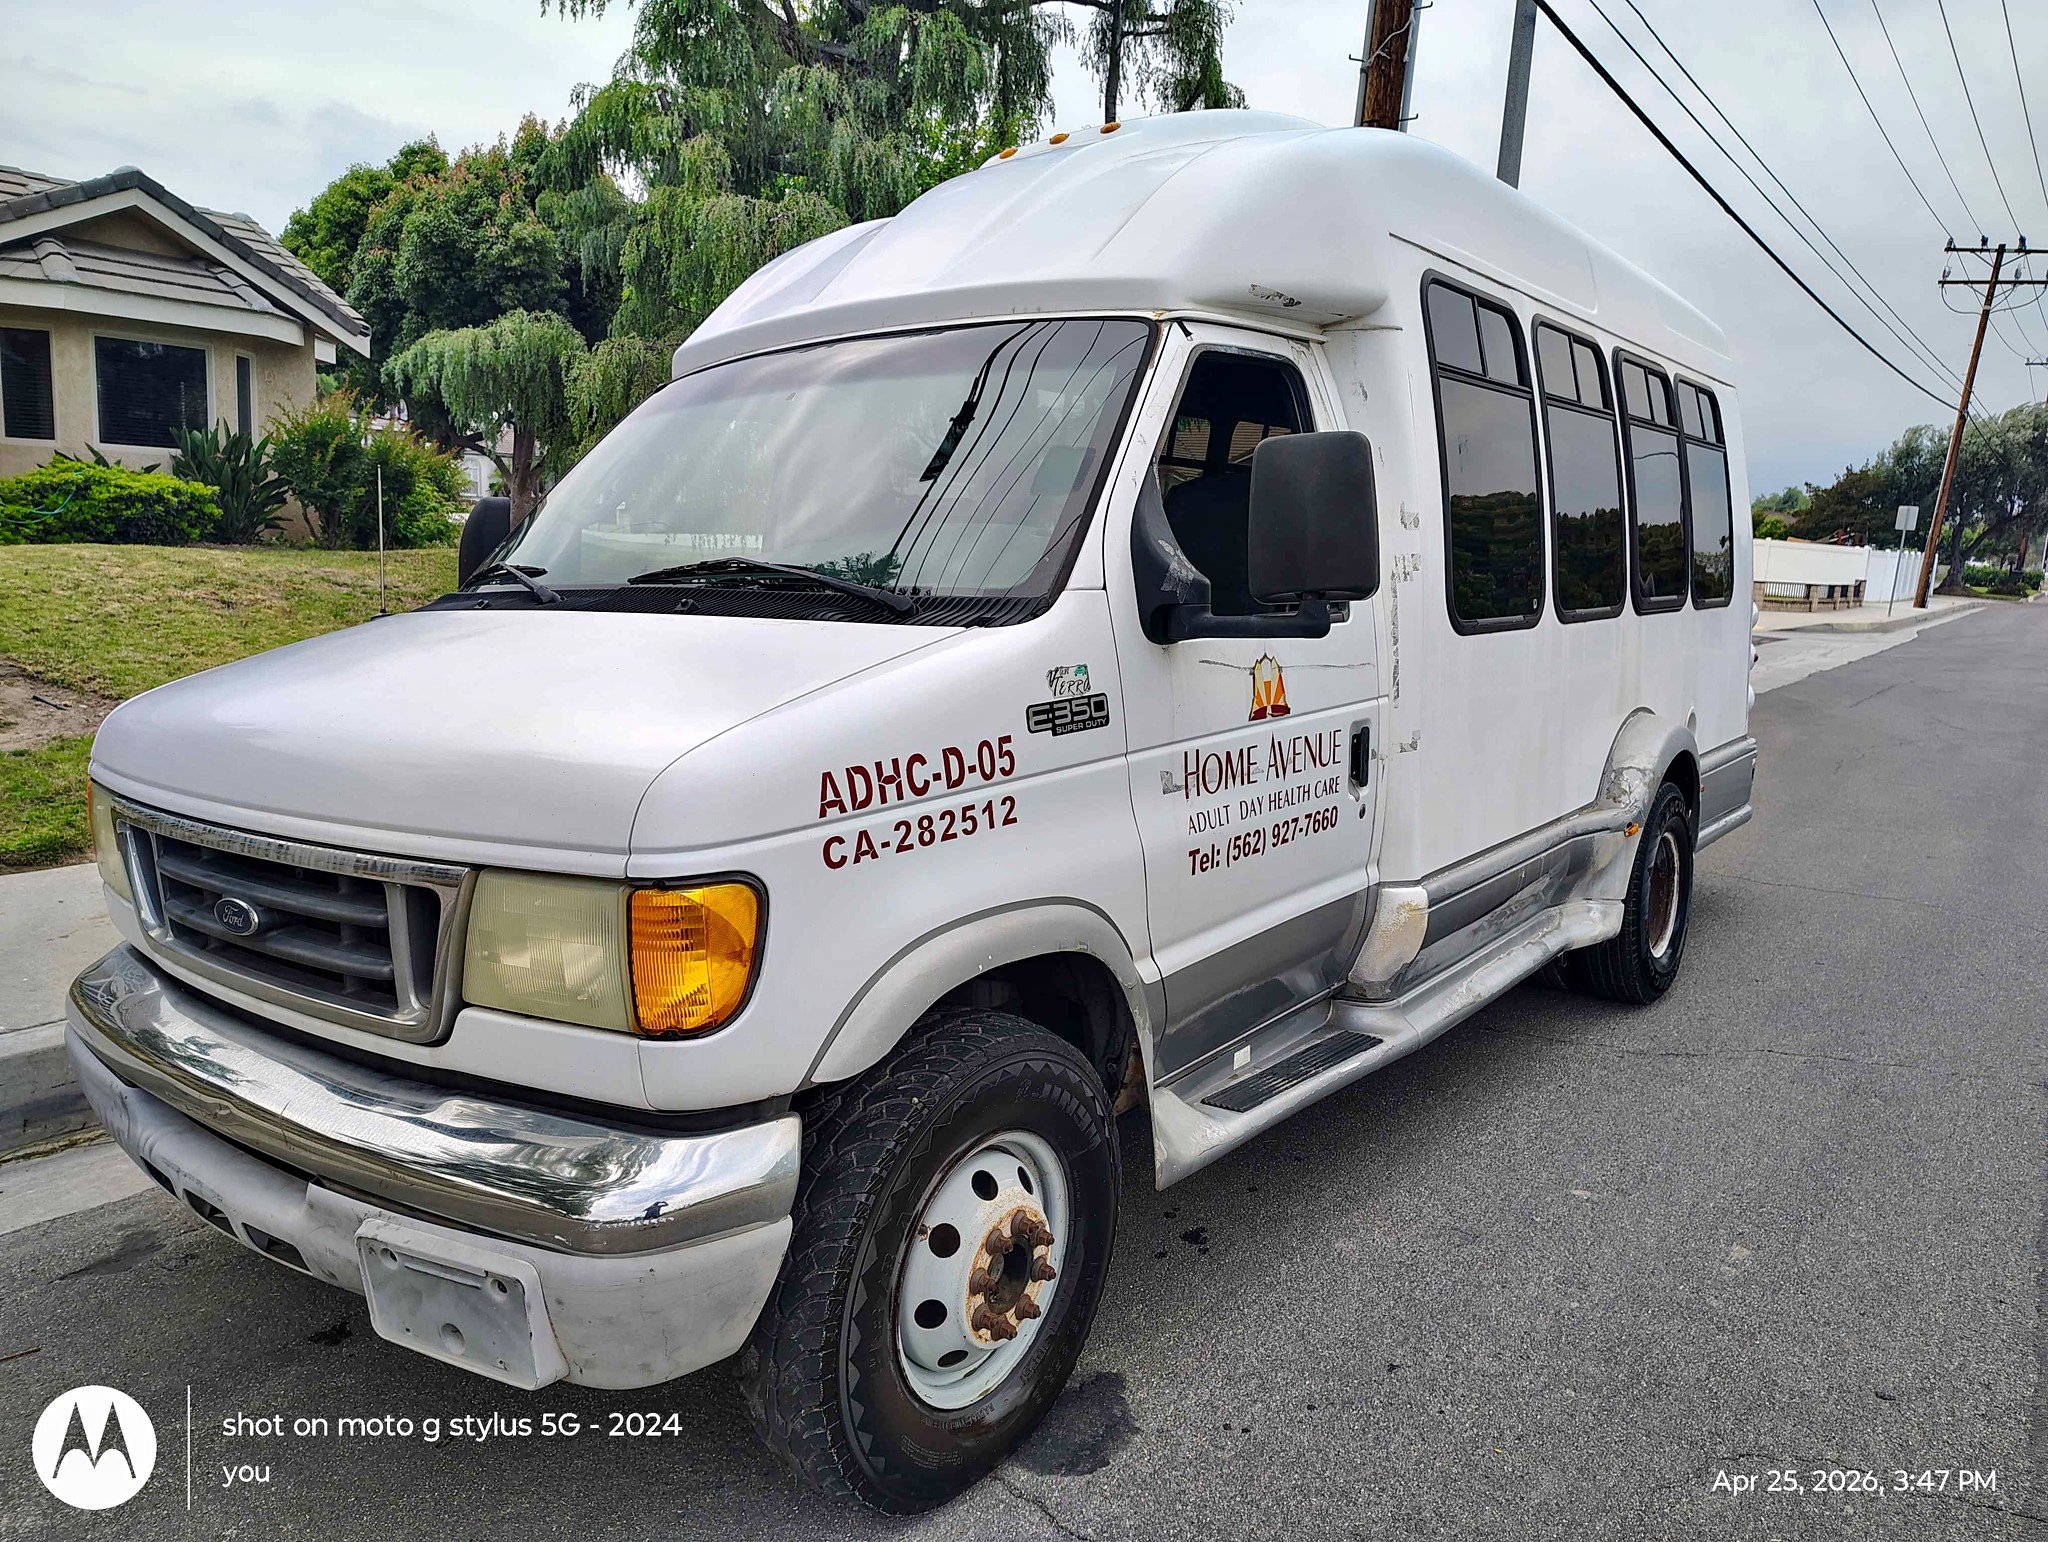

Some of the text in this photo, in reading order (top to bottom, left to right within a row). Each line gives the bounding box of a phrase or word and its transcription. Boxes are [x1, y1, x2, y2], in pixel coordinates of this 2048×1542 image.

[1028, 695, 1108, 731] E-350
[1056, 717, 1107, 734] SUPER DUTY
[818, 734, 1016, 819] ADHC-D-05
[1183, 729, 1342, 800] HOME AVENUE
[822, 795, 1018, 870] CA-282512
[1188, 775, 1341, 836] ADULT DAY HEALTH CARE
[1188, 805, 1339, 876] Tel: (562) 927-7660
[223, 905, 244, 927] Ford
